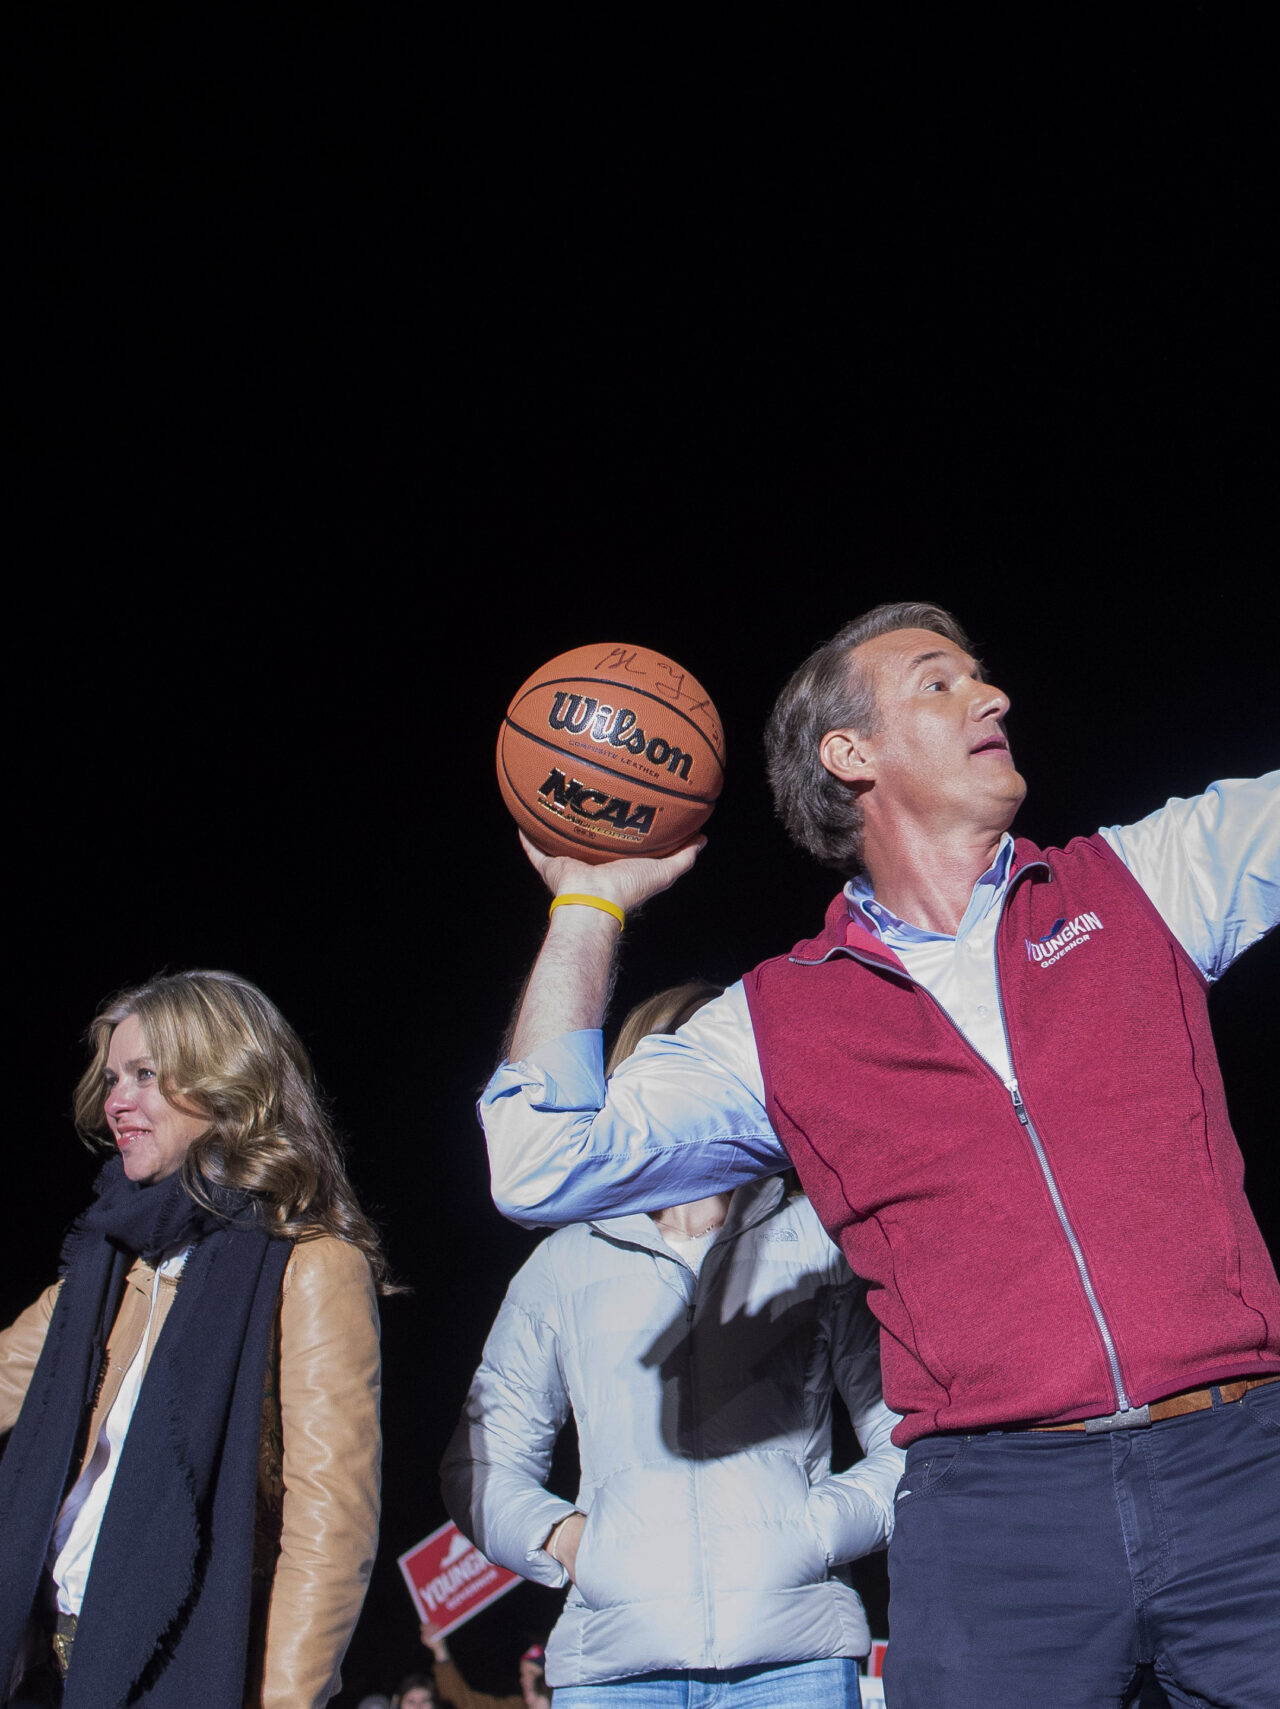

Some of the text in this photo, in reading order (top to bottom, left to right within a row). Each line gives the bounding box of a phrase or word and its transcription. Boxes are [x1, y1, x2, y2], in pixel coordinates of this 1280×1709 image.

[548, 691, 695, 784] Wilson
[620, 757, 660, 779] LEATHER
[537, 767, 657, 835] NCAA
[1040, 934, 1091, 969] GOVERNOR
